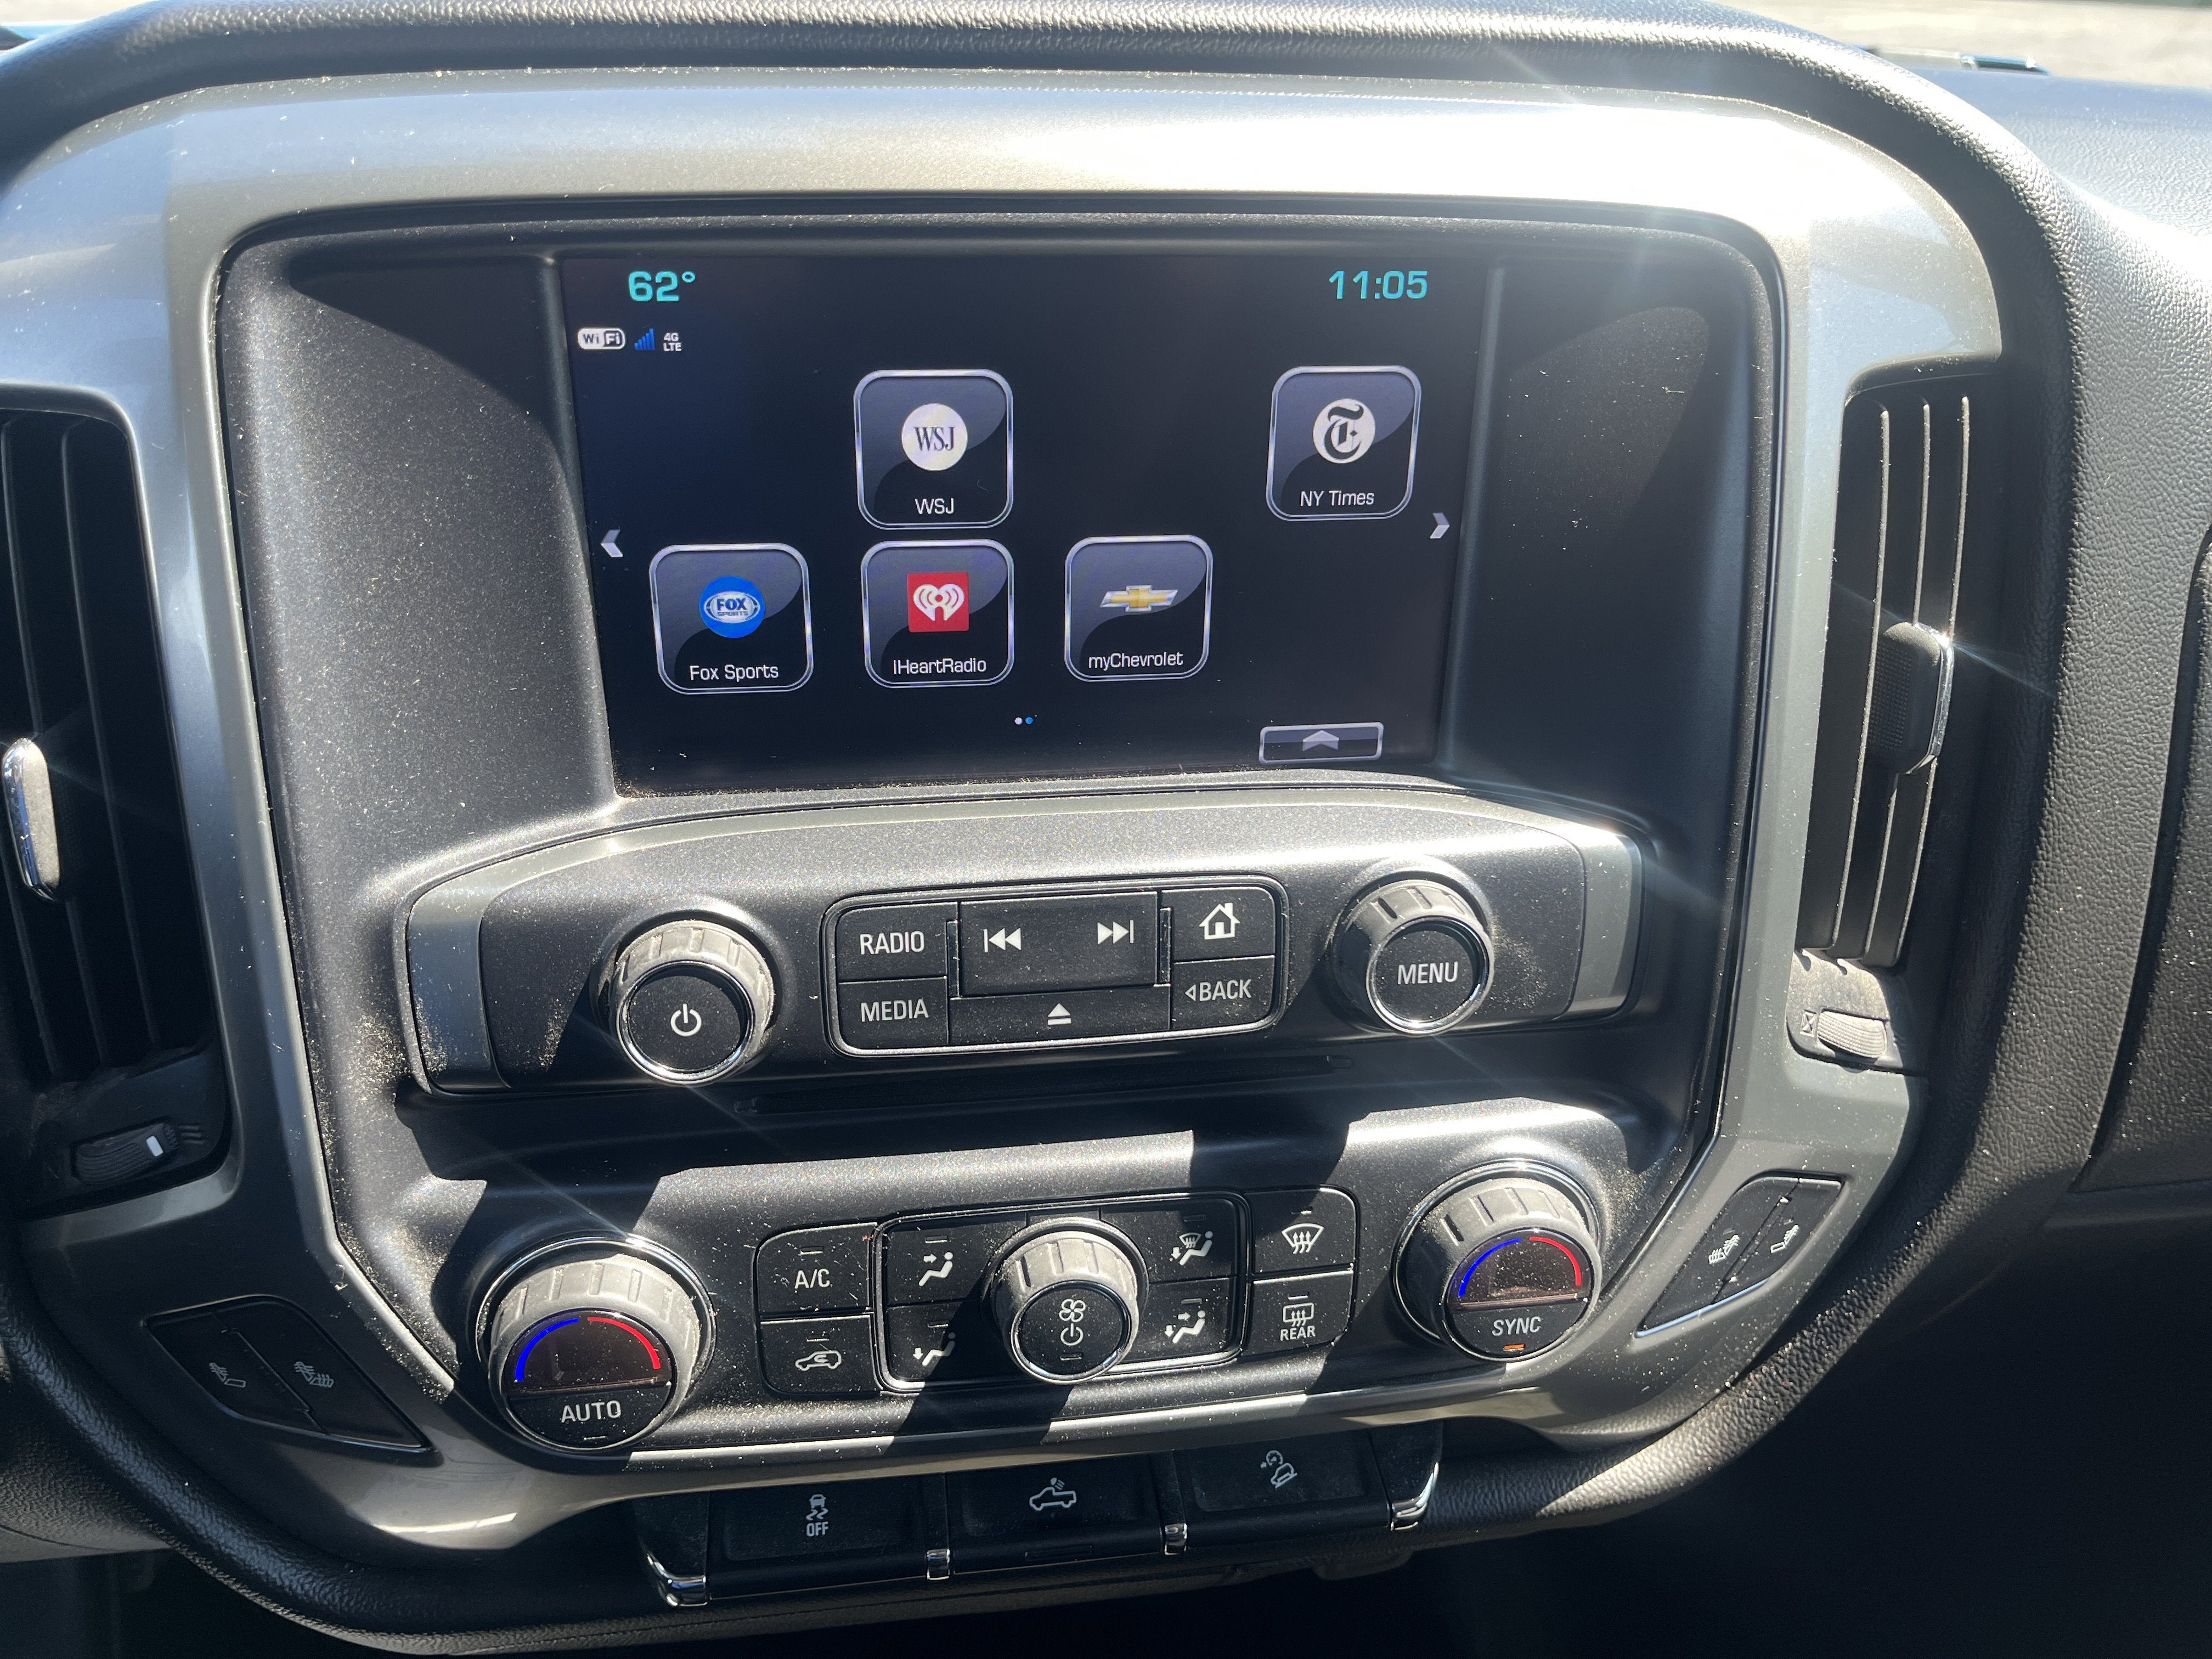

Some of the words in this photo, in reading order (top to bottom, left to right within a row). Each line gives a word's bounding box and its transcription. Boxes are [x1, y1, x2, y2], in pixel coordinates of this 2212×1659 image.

[628, 271, 696, 301] 62°
[1329, 270, 1427, 299] 11:05
[663, 332, 679, 342] 4G
[663, 342, 682, 352] LTE
[913, 426, 955, 452] WSJ
[915, 498, 955, 515] WSJ
[1300, 491, 1324, 506] NY
[1328, 490, 1374, 506] Times
[716, 597, 747, 611] FOX
[894, 658, 986, 674] iHeartRadio
[1088, 651, 1184, 670] myChevrolet
[690, 665, 719, 681] Fox
[724, 664, 778, 682] Sports
[860, 930, 924, 955] RADIO
[1397, 961, 1458, 985] MENU
[1199, 979, 1252, 1002] BACK
[861, 997, 928, 1023] MEDIA
[794, 1268, 830, 1289] A/C
[1280, 1325, 1316, 1341] REAR
[1492, 1316, 1541, 1336] SYNC
[561, 1400, 622, 1424] AUTO
[806, 1521, 829, 1537] OFF
